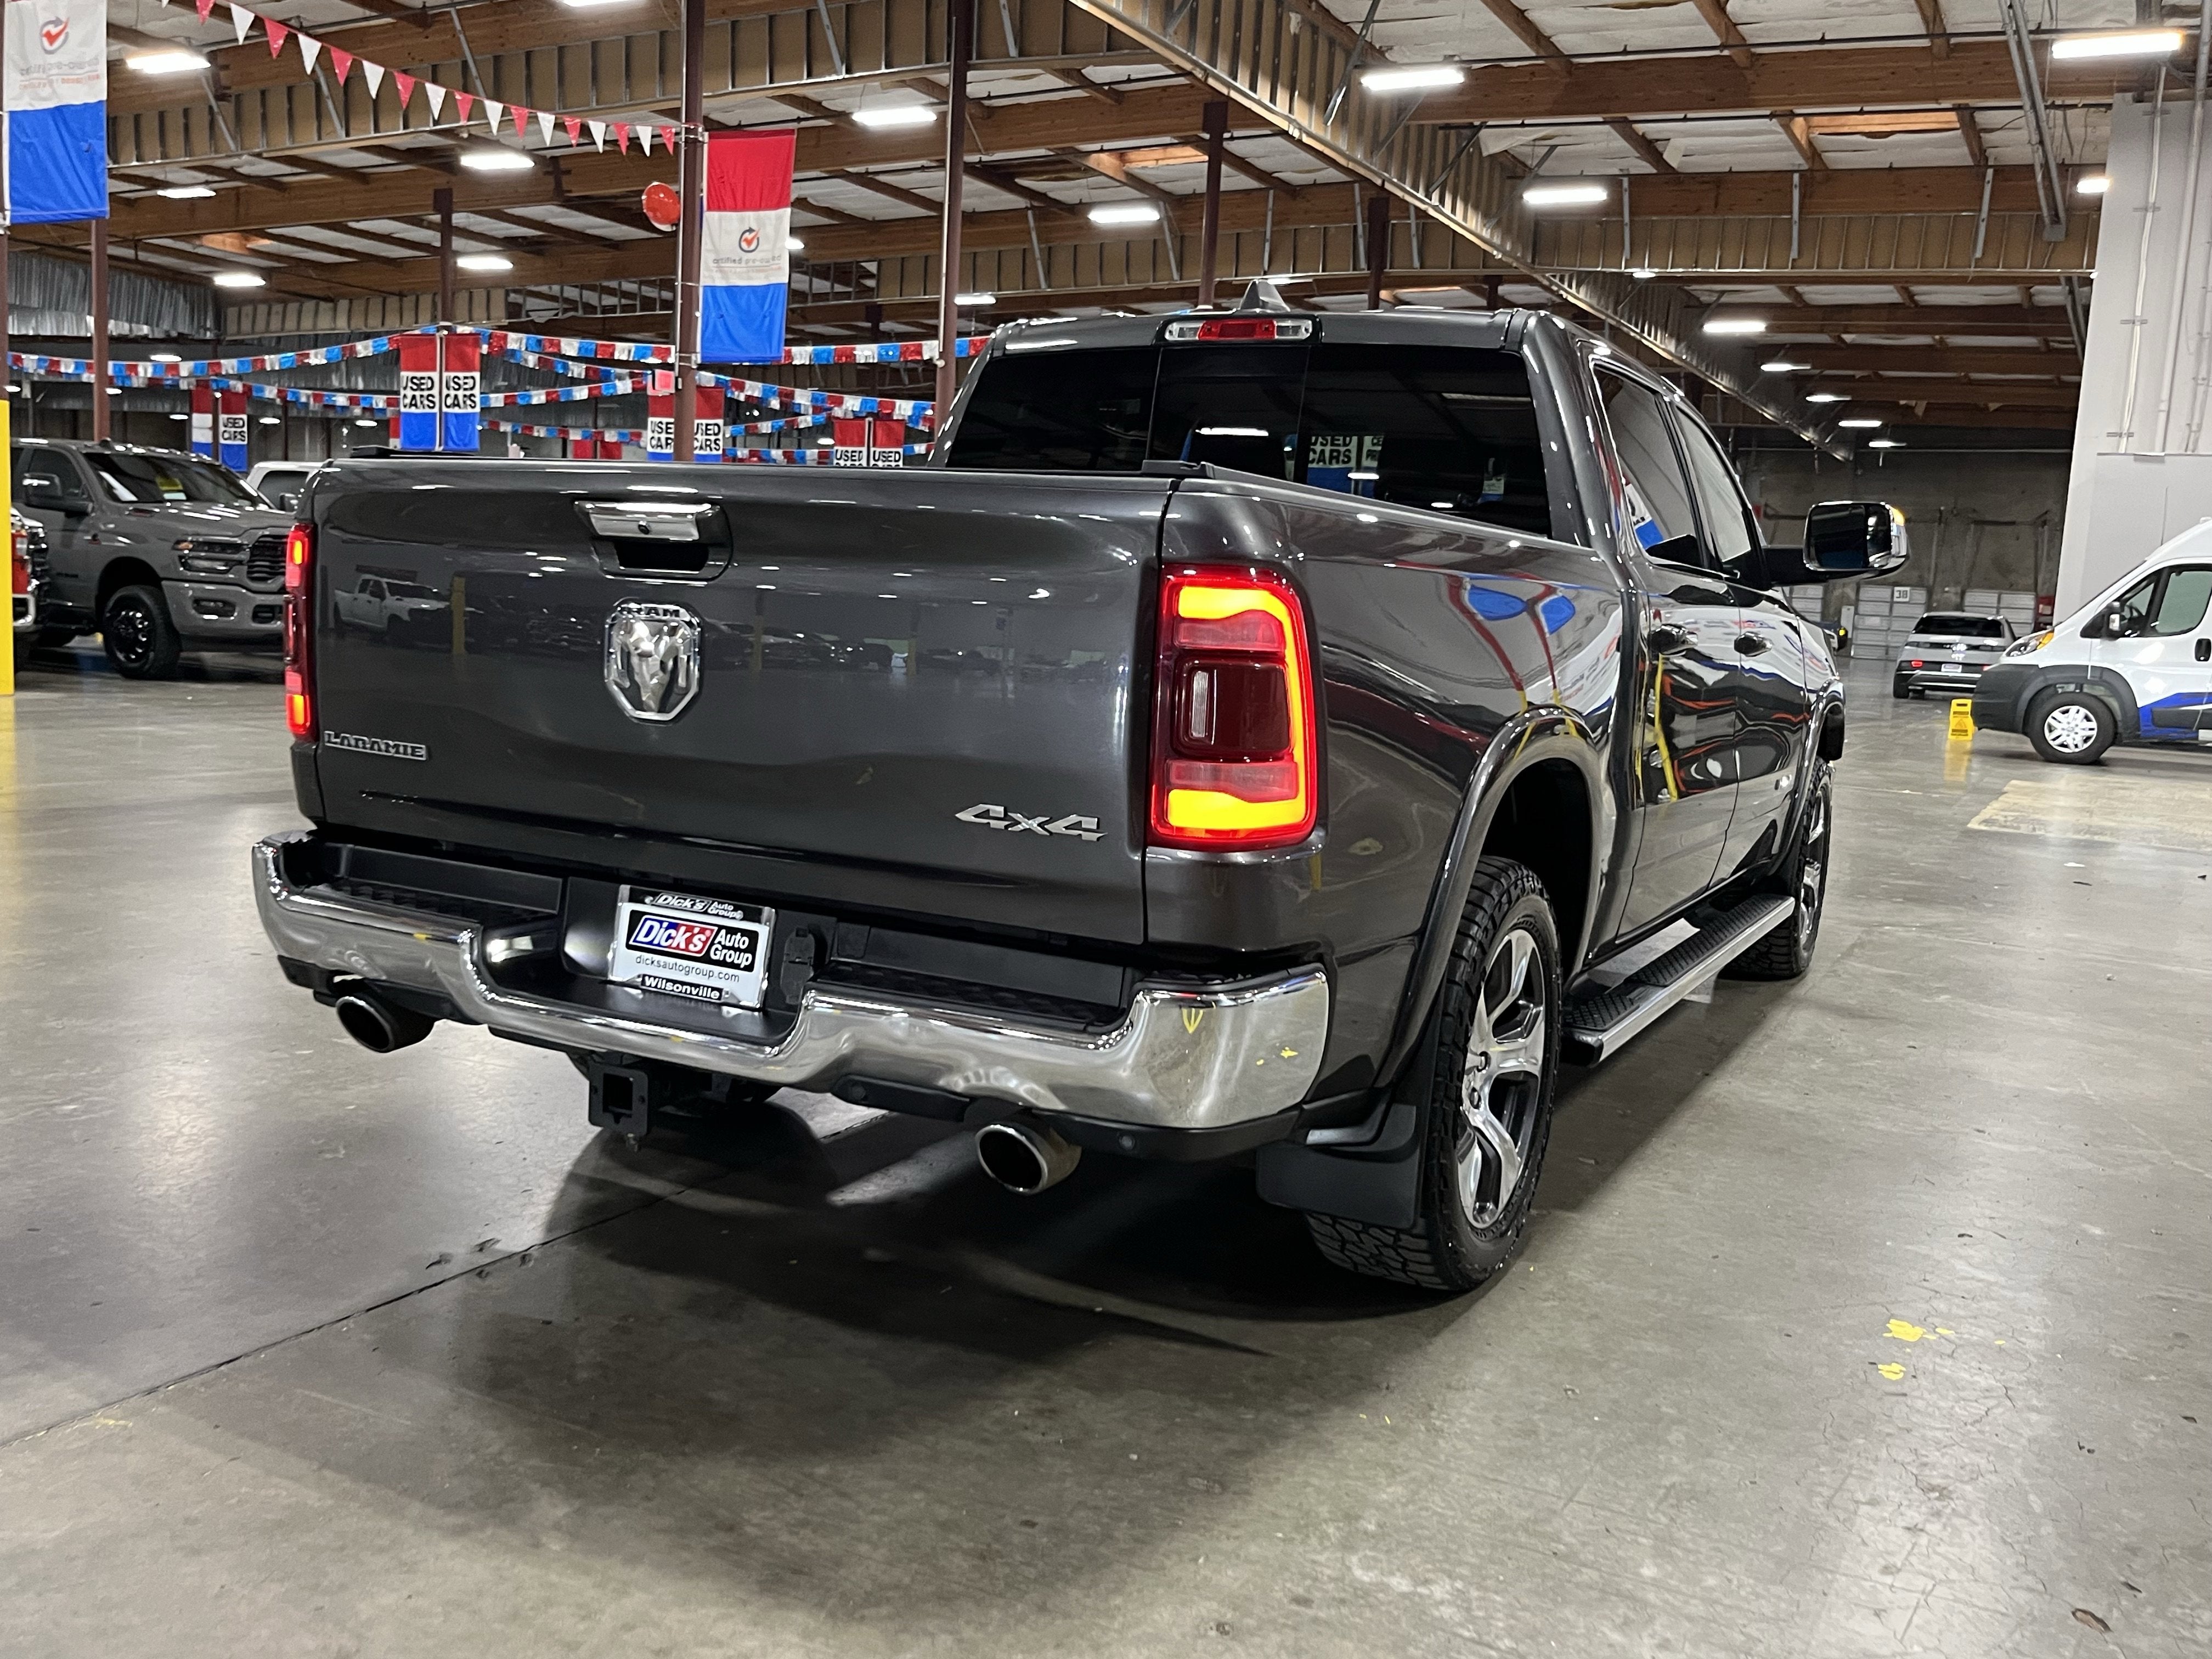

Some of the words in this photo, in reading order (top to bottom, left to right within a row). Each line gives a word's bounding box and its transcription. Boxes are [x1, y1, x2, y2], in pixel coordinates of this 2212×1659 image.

[401, 375, 435, 391] USED
[445, 375, 476, 391] USED
[402, 393, 436, 409] CARS
[444, 393, 477, 409] CARS
[650, 421, 674, 434] USE
[650, 437, 674, 450] CAR
[835, 449, 864, 462] USED
[873, 450, 901, 462] USED
[1309, 448, 1352, 465] CARS
[324, 731, 426, 760] LARAMIE
[658, 895, 707, 910] Dick's
[713, 901, 734, 911] Auto
[708, 906, 737, 919] Group
[636, 920, 708, 952] Dick's
[714, 929, 749, 949] Auto
[710, 944, 752, 968] Group
[635, 954, 740, 983] dicksautogroup.com
[644, 975, 720, 1000] Wilsonville
